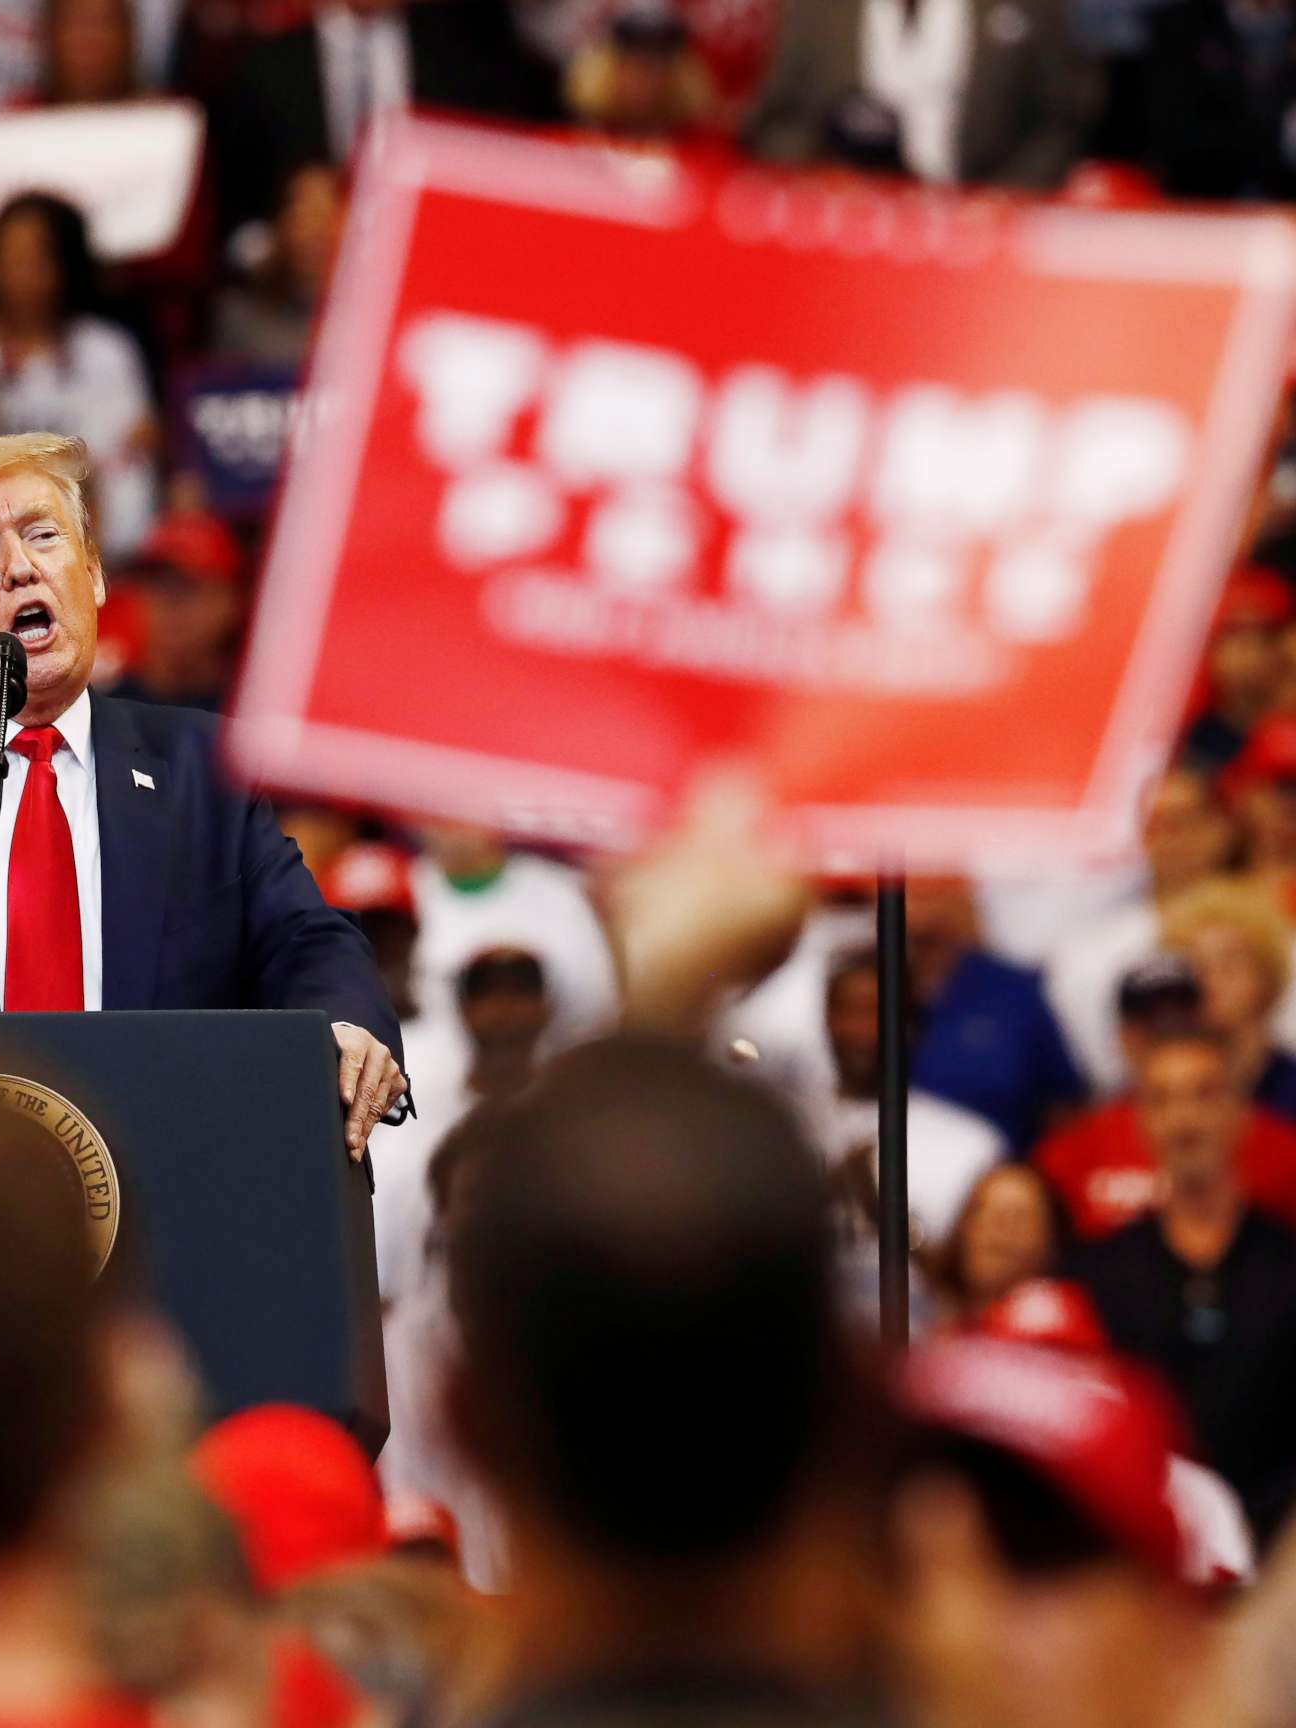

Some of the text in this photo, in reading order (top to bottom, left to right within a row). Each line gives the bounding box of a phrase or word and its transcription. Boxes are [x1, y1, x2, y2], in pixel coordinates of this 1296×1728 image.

[396, 310, 1194, 532] TRUMP
[15, 1091, 48, 1117] THE
[54, 1111, 111, 1221] UNITED
